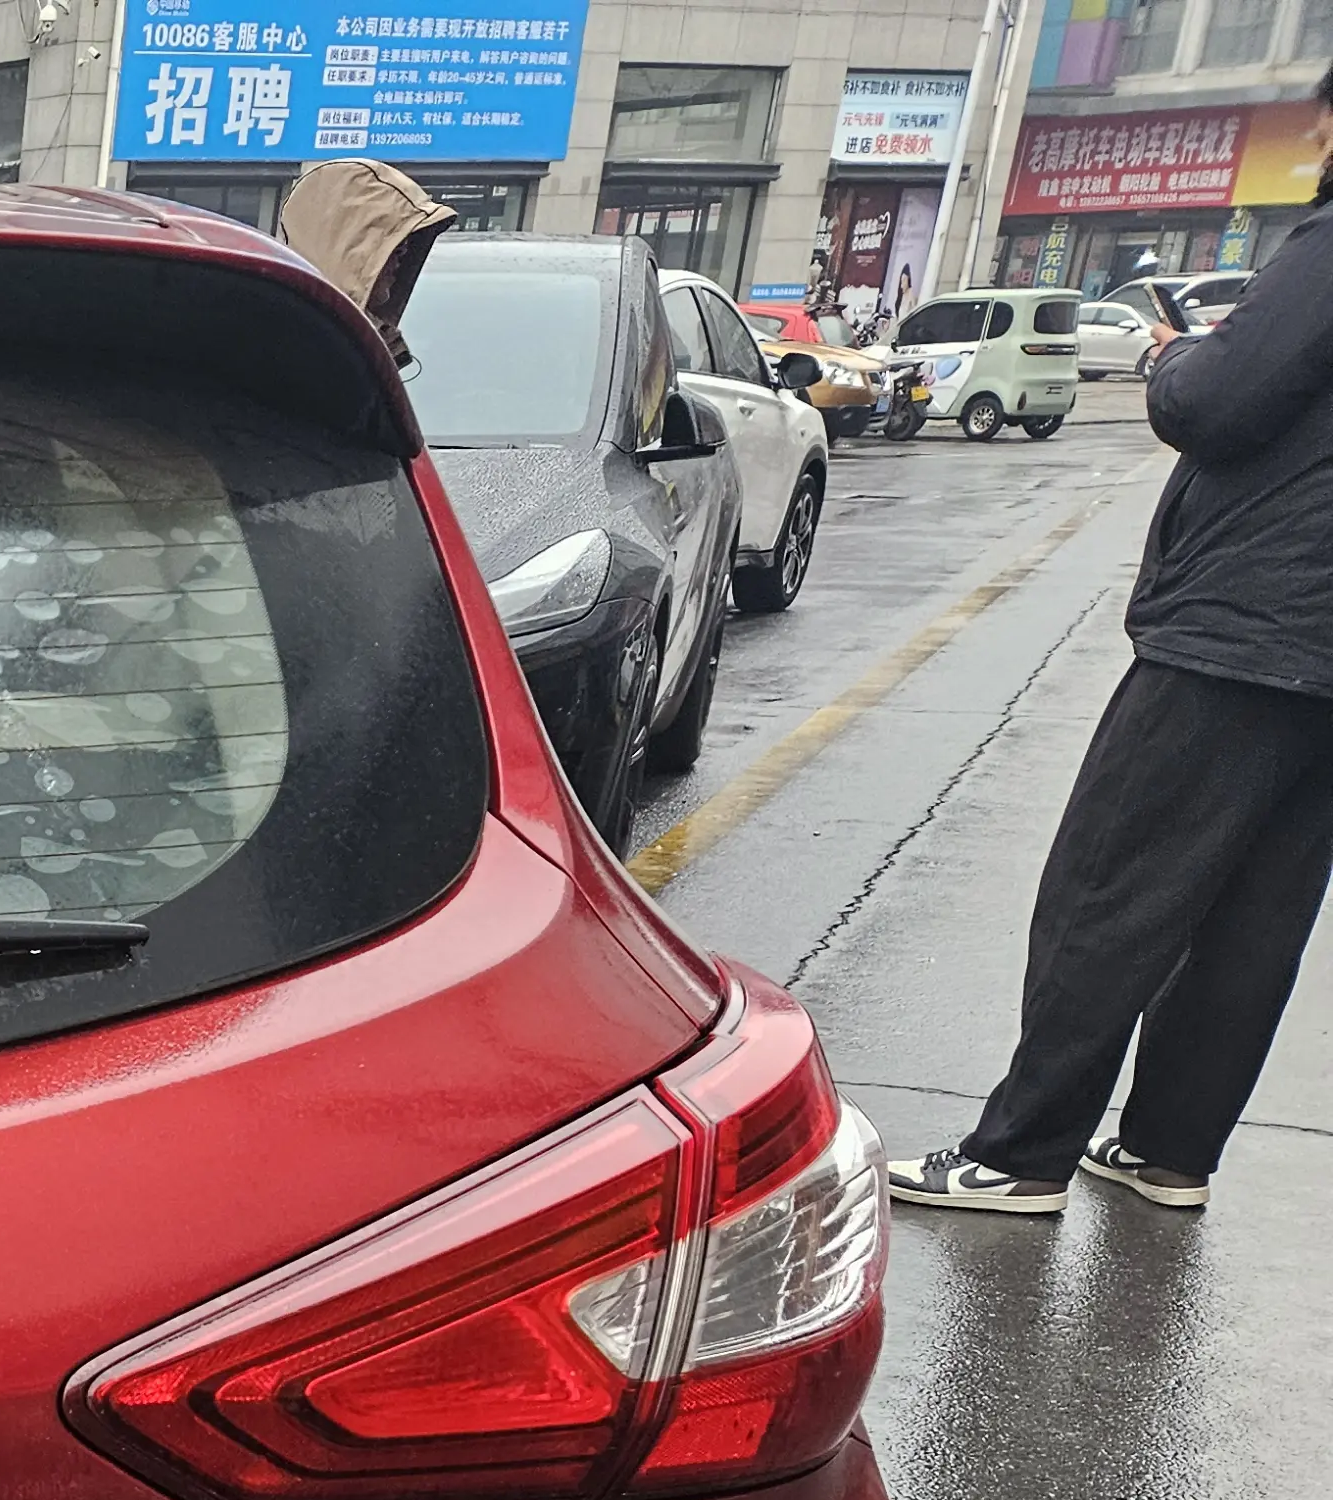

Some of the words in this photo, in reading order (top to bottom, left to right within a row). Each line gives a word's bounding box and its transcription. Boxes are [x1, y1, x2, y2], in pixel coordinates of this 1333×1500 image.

[142, 21, 307, 52] 10086客服中心
[145, 62, 292, 147] 招聘
